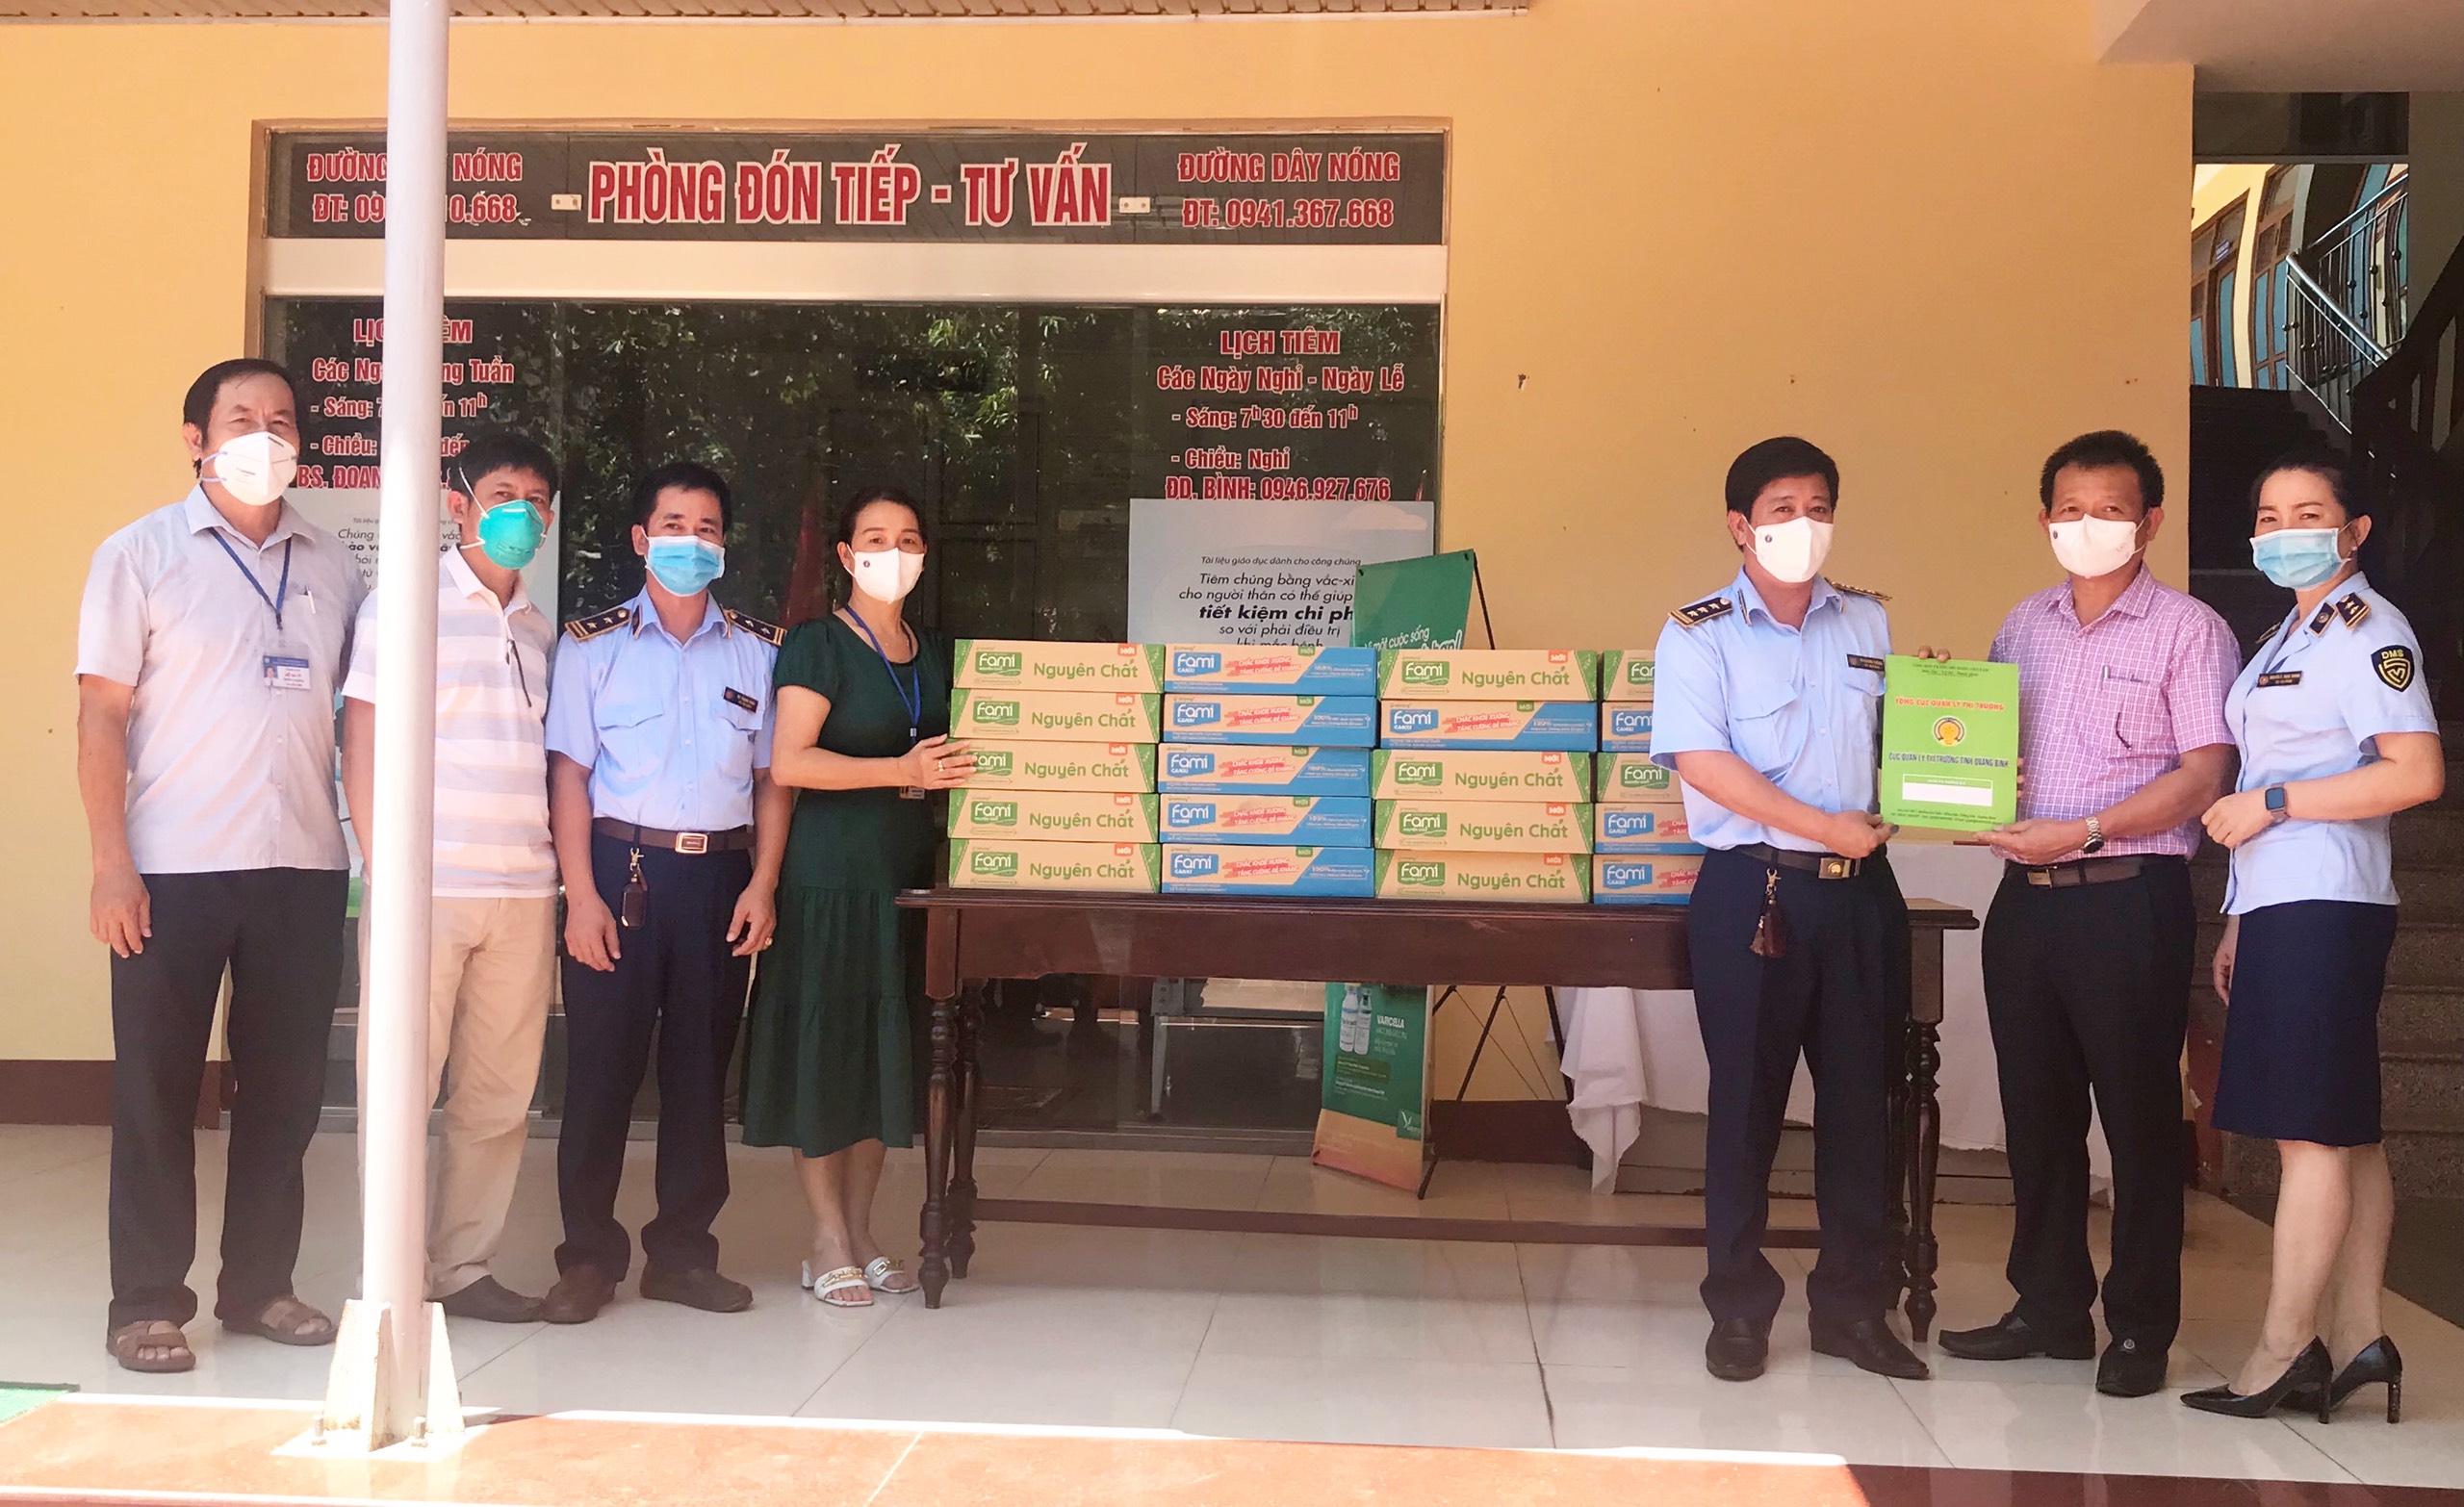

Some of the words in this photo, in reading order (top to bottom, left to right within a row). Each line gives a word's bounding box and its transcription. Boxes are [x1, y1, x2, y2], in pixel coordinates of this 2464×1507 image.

[453, 147, 523, 181] NÓNG
[1178, 146, 1265, 182] ĐƯỜNG
[1271, 147, 1322, 182] DÂY
[1328, 146, 1399, 182] NÓNG
[588, 147, 726, 223] PHÒNG
[734, 149, 822, 223] ĐÓN
[832, 143, 921, 225] TIẾP
[931, 185, 952, 203] -
[961, 158, 1018, 227] TƯ
[1025, 142, 1112, 226] VẤN
[312, 193, 348, 221] ĐT:
[1182, 199, 1219, 227] ĐT:
[1225, 198, 1394, 227] 0941.367.668
[1220, 331, 1274, 359] LỊCH
[1281, 326, 1340, 355] TIÊM
[312, 357, 349, 381] Các
[469, 354, 515, 384] Tuần
[1157, 365, 1195, 390] Các
[1200, 366, 1251, 393] Ngày
[1257, 364, 1303, 393] Nghỉ
[1307, 376, 1318, 385] -
[1322, 367, 1373, 393] Ngày
[1379, 363, 1404, 391] Lễ
[323, 396, 373, 419] Sáng:
[1171, 413, 1181, 421] -
[1186, 407, 1237, 430] Sáng:
[1289, 405, 1322, 429] đến
[322, 432, 377, 456] Chiều:
[1170, 454, 1180, 463] -
[1185, 446, 1242, 470] Chiều:
[1247, 447, 1290, 471] Nghỉ
[297, 465, 329, 489] BS.
[1165, 476, 1197, 500] ĐD.
[1203, 472, 1256, 500] BÌNH:
[1260, 477, 1391, 501] 0946.927.676
[1199, 604, 1233, 620] tiết
[1237, 604, 1288, 623] kiệm
[1295, 605, 1322, 621] chi
[2381, 649, 2404, 659] DMS
[1034, 662, 1095, 679] Nguyên
[1100, 658, 1139, 678] Chất
[1462, 671, 1525, 687] Nguyên
[1530, 666, 1570, 686] Chất
[1031, 712, 1093, 728] Nguyên
[1098, 708, 1136, 728] Chất
[1024, 762, 1086, 779] Nguyên
[1091, 758, 1129, 778] Chất
[1455, 772, 1519, 789] Nguyên
[1524, 767, 1563, 787] Chất
[1029, 812, 1091, 829] Nguyên
[1097, 808, 1134, 828] Chất
[1459, 823, 1524, 840] Nguyên
[1528, 819, 1568, 838] Chất
[1030, 862, 1091, 880] Nguyên
[1096, 858, 1135, 879] Chất
[1457, 873, 1521, 890] Nguyên
[1527, 869, 1565, 889] Chất
[1376, 1014, 1405, 1029] VARICELLA
